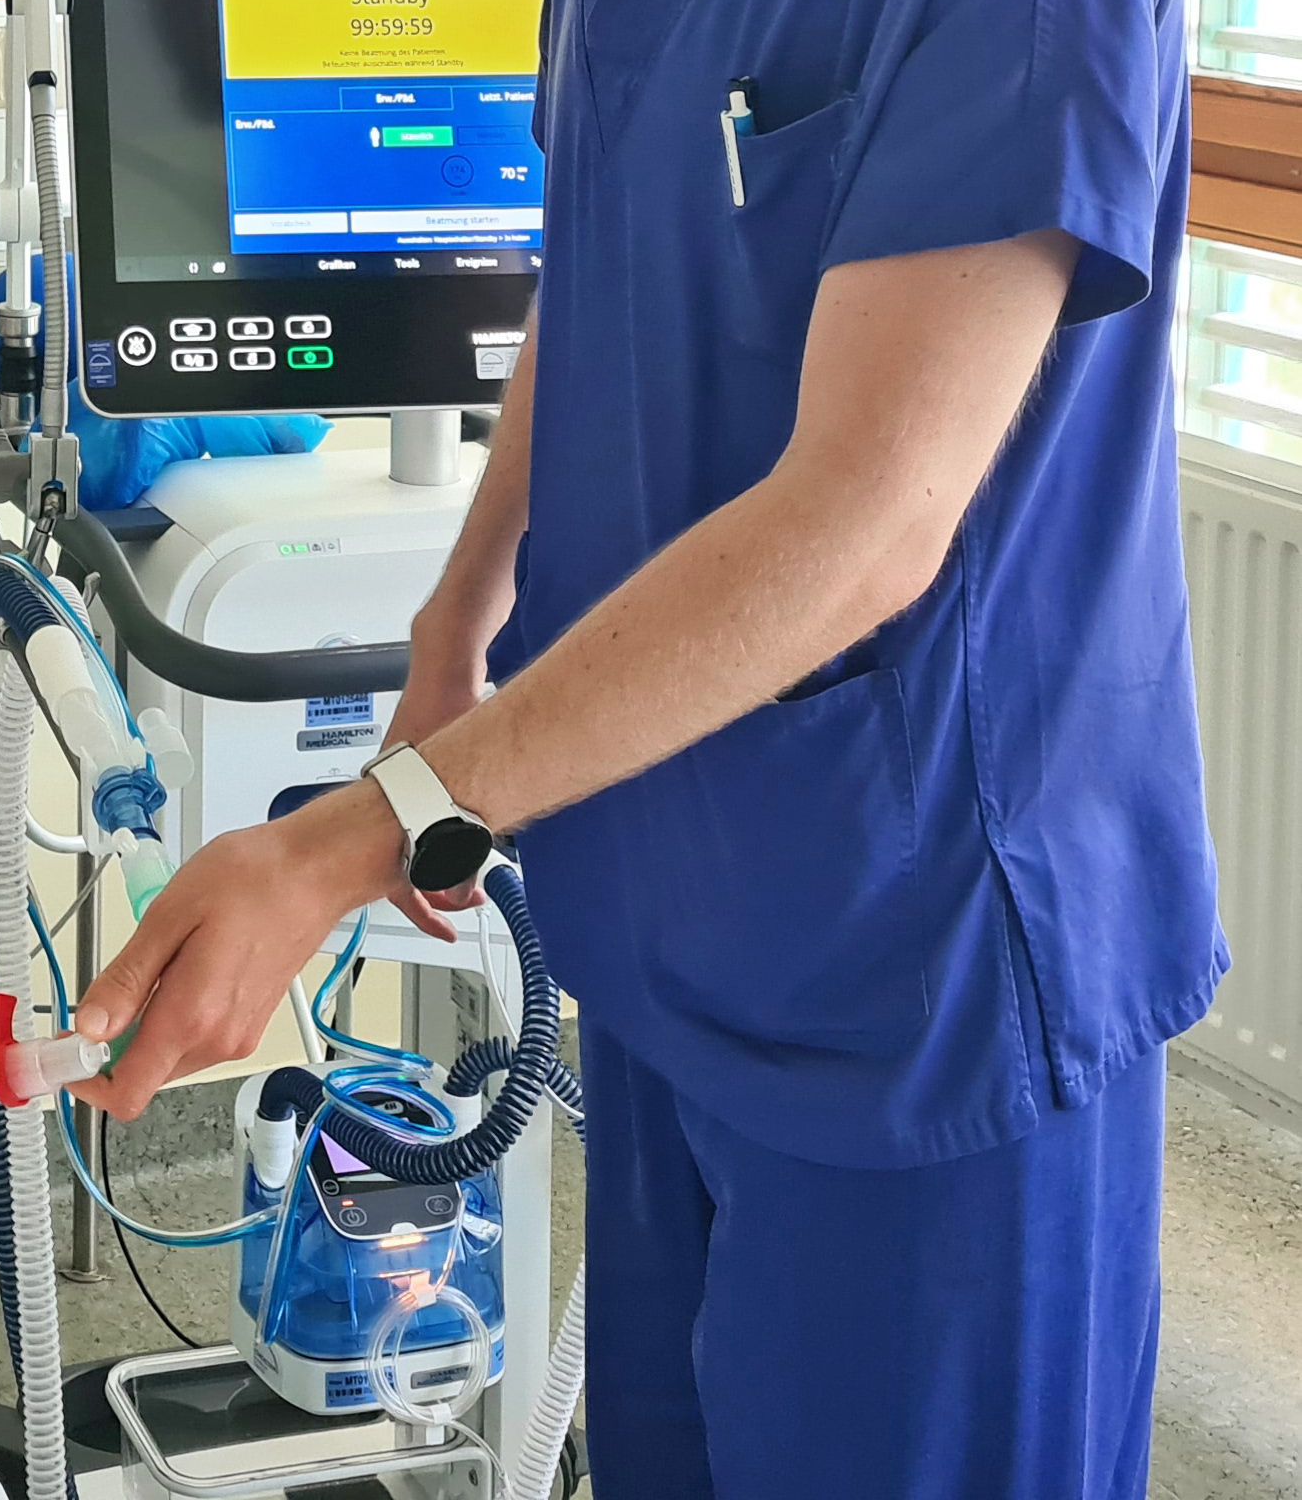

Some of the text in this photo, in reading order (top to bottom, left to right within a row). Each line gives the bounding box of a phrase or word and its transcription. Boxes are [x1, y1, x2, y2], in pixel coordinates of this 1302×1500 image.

[350, 18, 433, 36] 99:59:59
[504, 92, 535, 101] Patient
[500, 167, 516, 180] 70
[426, 216, 468, 226] Beatmung
[394, 258, 420, 269] Tools
[456, 257, 498, 270] Ereignisse
[322, 728, 374, 740] HAMILTON
[306, 739, 351, 748] MEDICAL
